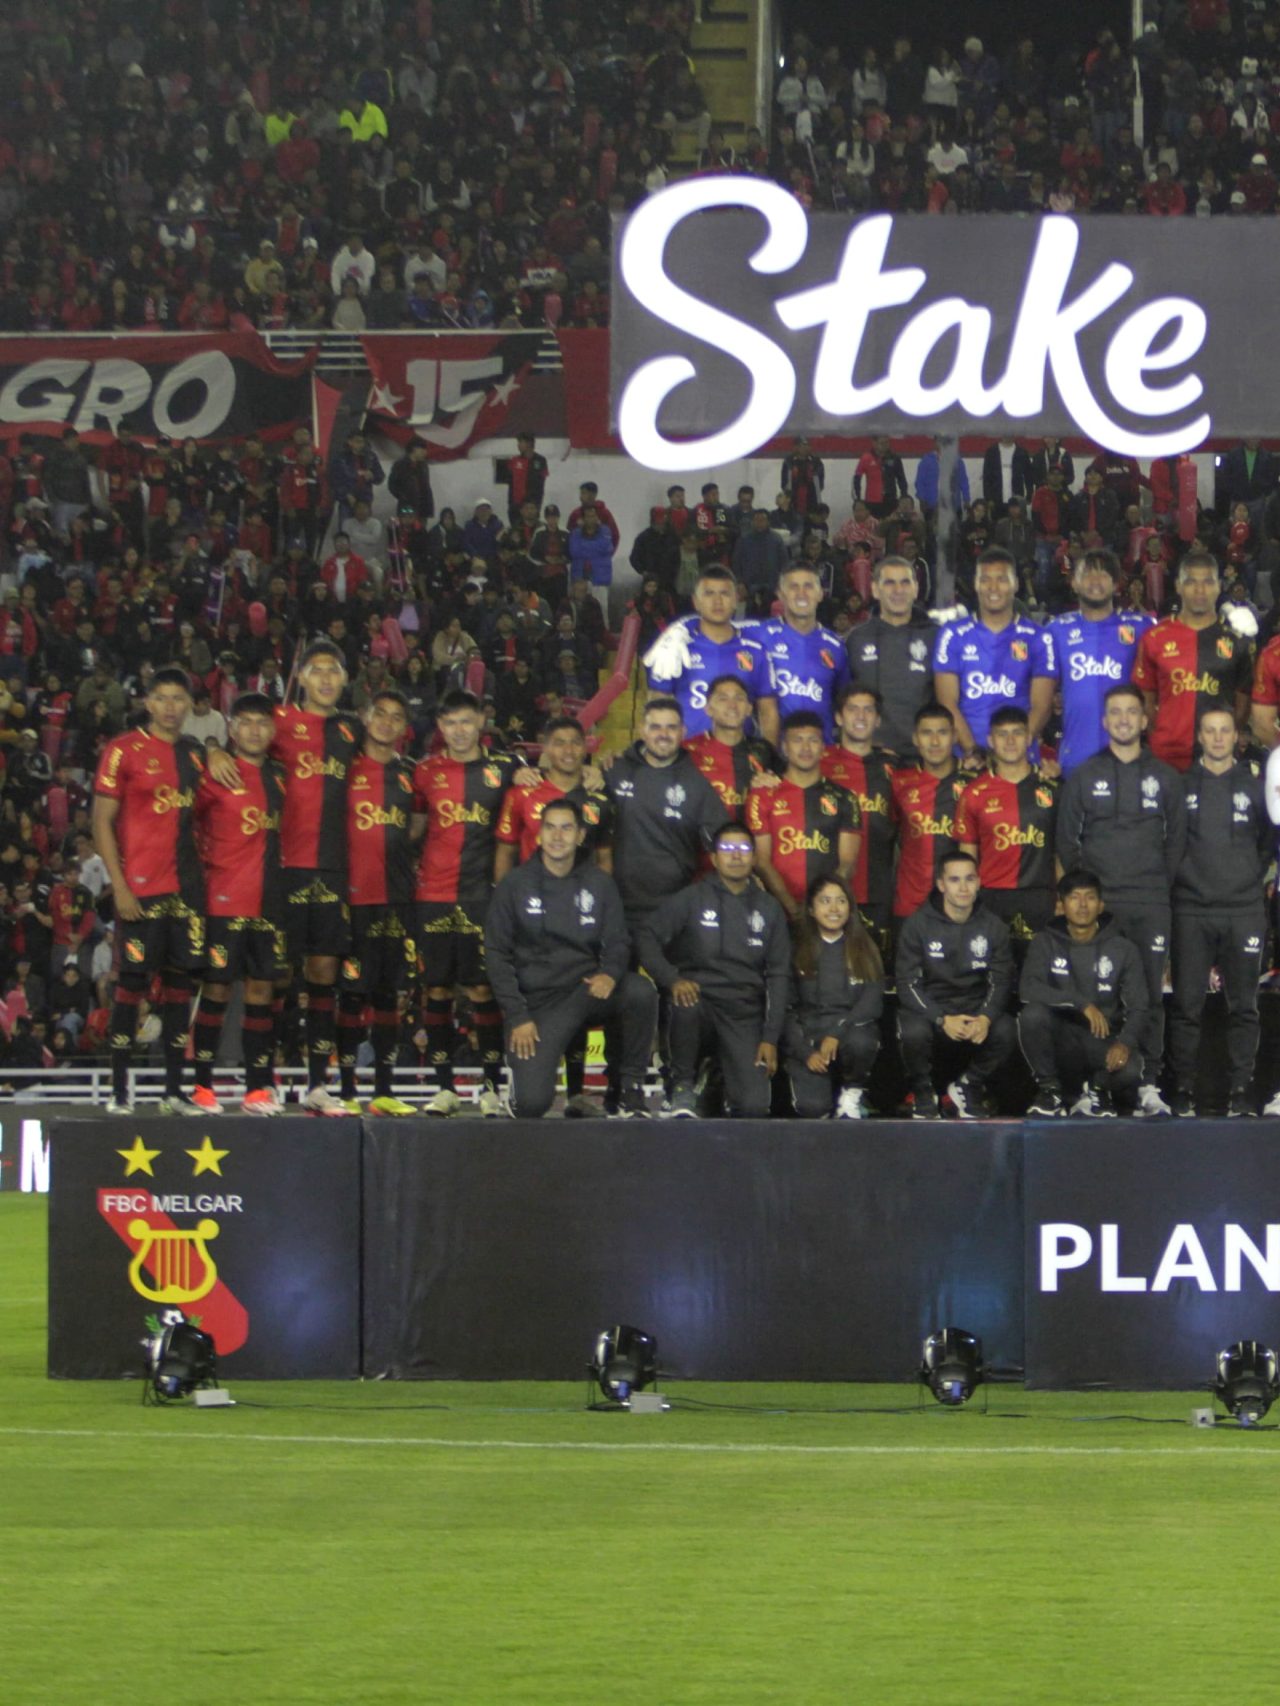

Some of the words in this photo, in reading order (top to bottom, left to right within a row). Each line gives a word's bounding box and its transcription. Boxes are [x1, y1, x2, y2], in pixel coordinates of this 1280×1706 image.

[618, 176, 1211, 472] Stake
[1070, 652, 1122, 681] Stake
[1171, 667, 1220, 695] Stake
[776, 669, 823, 702] Stake
[966, 671, 1016, 699] Stake
[295, 752, 346, 780] Stake
[152, 784, 193, 815] Stak
[437, 799, 490, 828] Stake
[857, 791, 888, 815] take
[355, 800, 406, 831] Stake
[778, 825, 830, 855] Stake
[993, 822, 1045, 851] Stake
[103, 1194, 147, 1213] FBC
[152, 1194, 244, 1213] MELGAR
